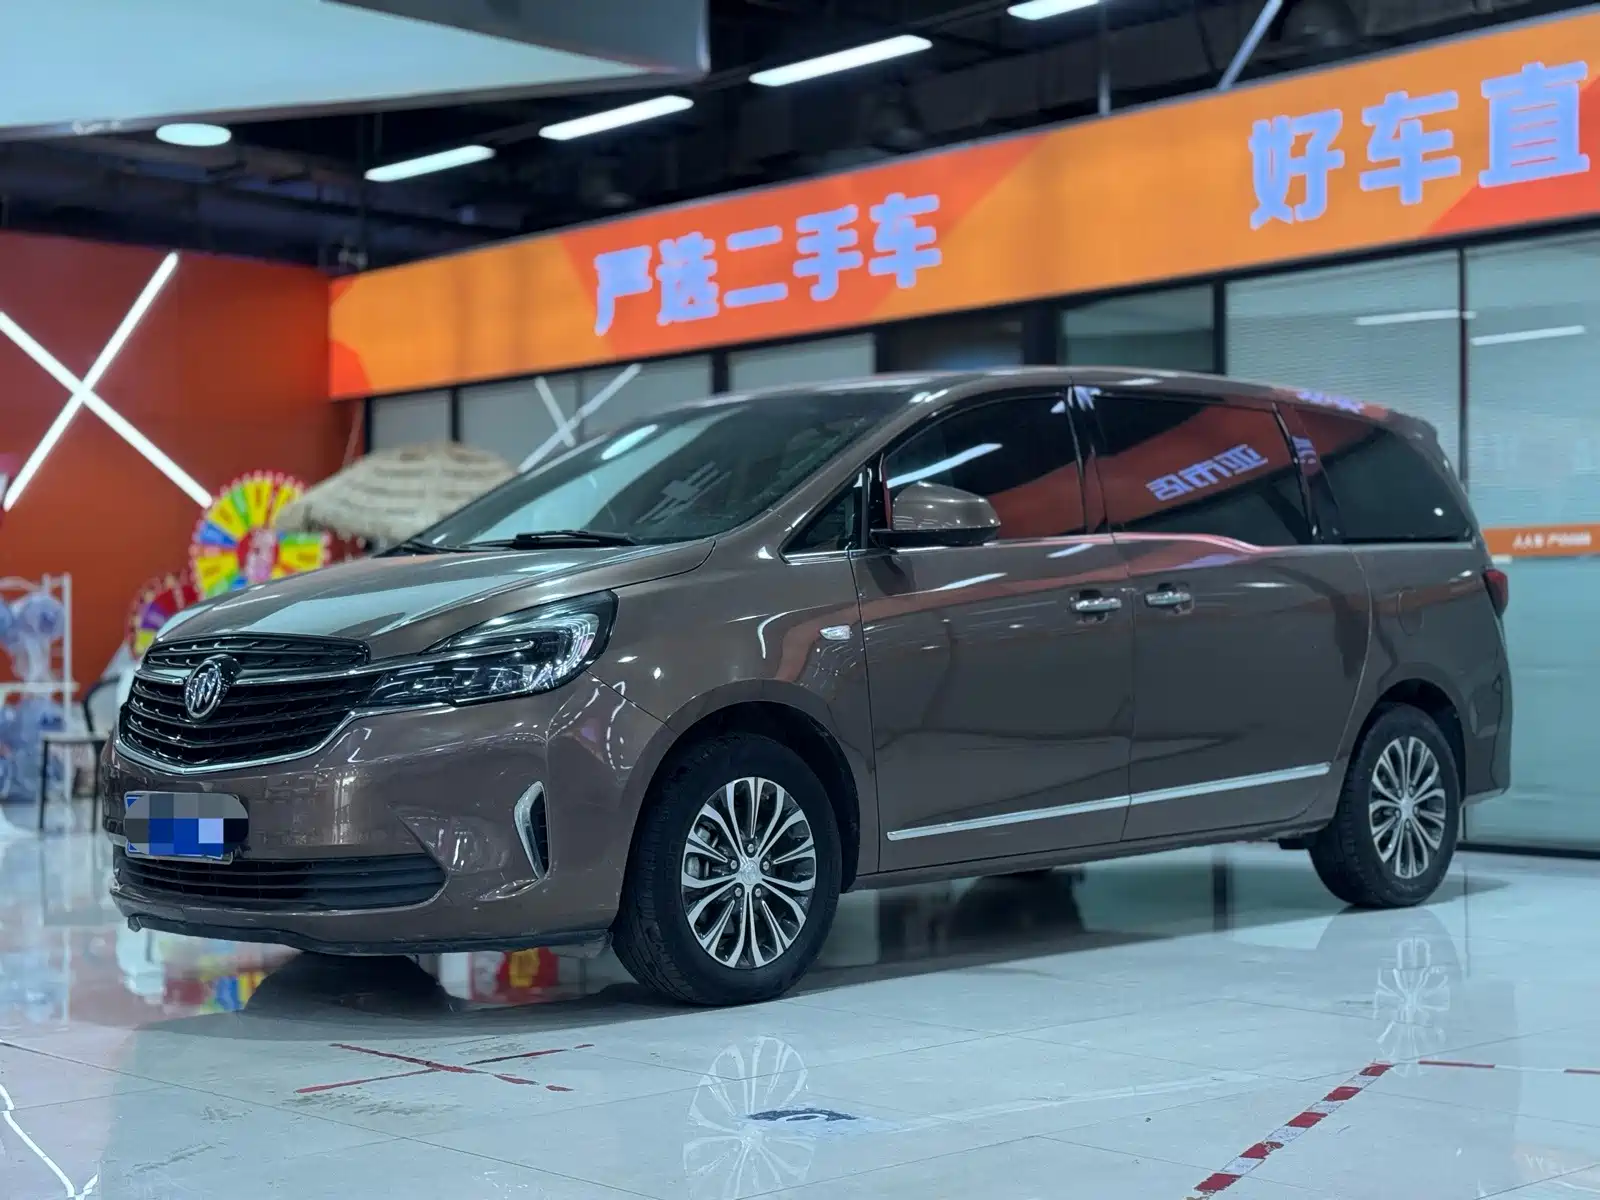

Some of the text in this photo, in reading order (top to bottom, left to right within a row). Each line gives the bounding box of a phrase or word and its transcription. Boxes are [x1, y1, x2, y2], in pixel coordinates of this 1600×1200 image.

[1248, 60, 1590, 230] 好车直
[594, 192, 943, 336] 严选二手车
